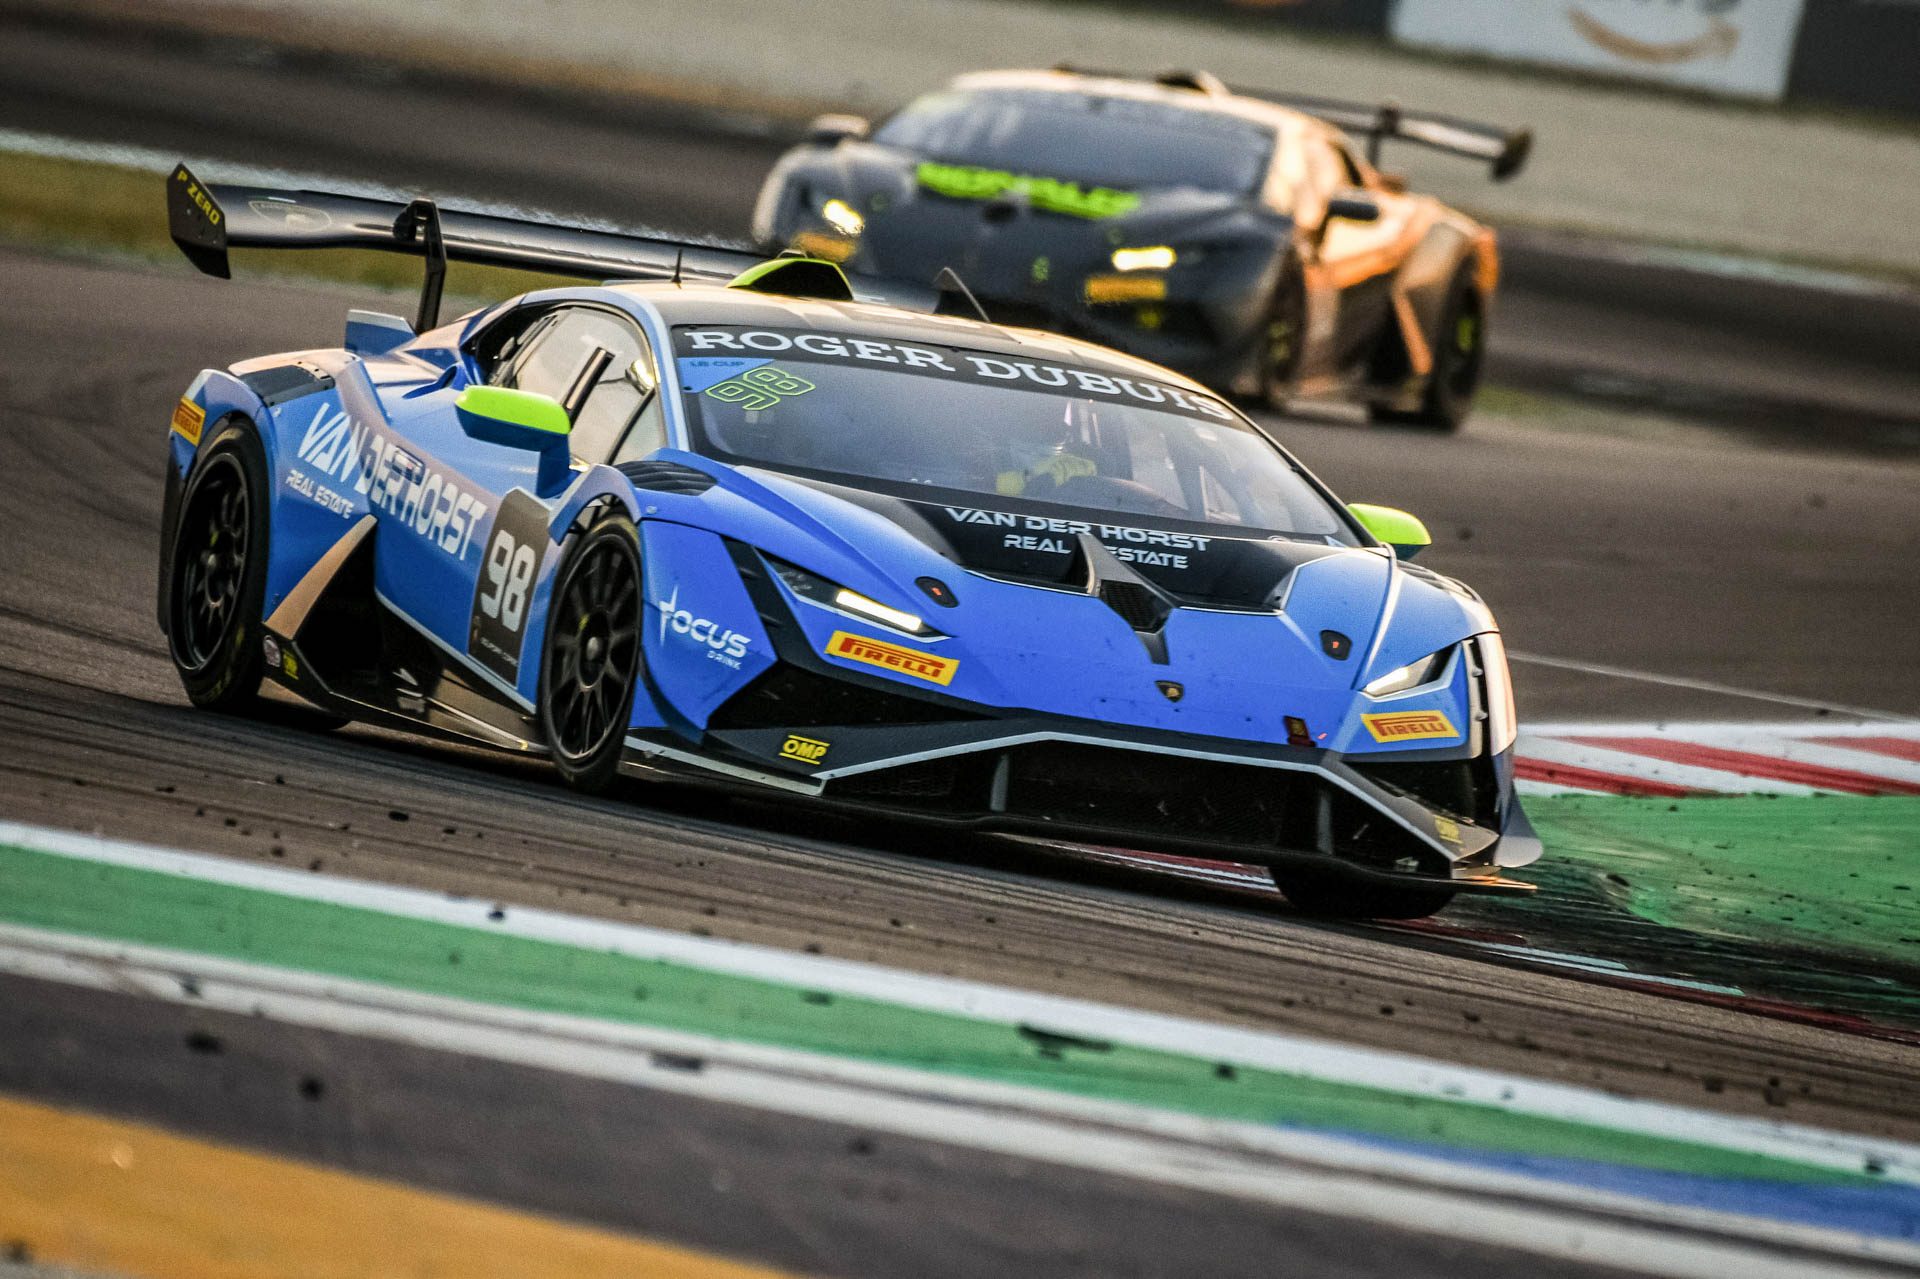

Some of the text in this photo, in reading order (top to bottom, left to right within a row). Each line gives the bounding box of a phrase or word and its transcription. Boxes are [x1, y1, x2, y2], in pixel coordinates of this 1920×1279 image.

[187, 184, 220, 225] ZERO
[684, 331, 1233, 420] ROGER DUBUIS
[705, 366, 816, 411] 98
[284, 468, 355, 520] REAL ESTATE
[297, 402, 369, 482] VAN
[400, 466, 488, 561] HORST
[945, 507, 1212, 551] VAN DER HORST
[1004, 534, 1072, 555] REAL
[480, 529, 536, 633] 98
[838, 637, 946, 678] PIRELLI
[1370, 715, 1448, 737] PIRELLI
[783, 739, 828, 761] OMP
